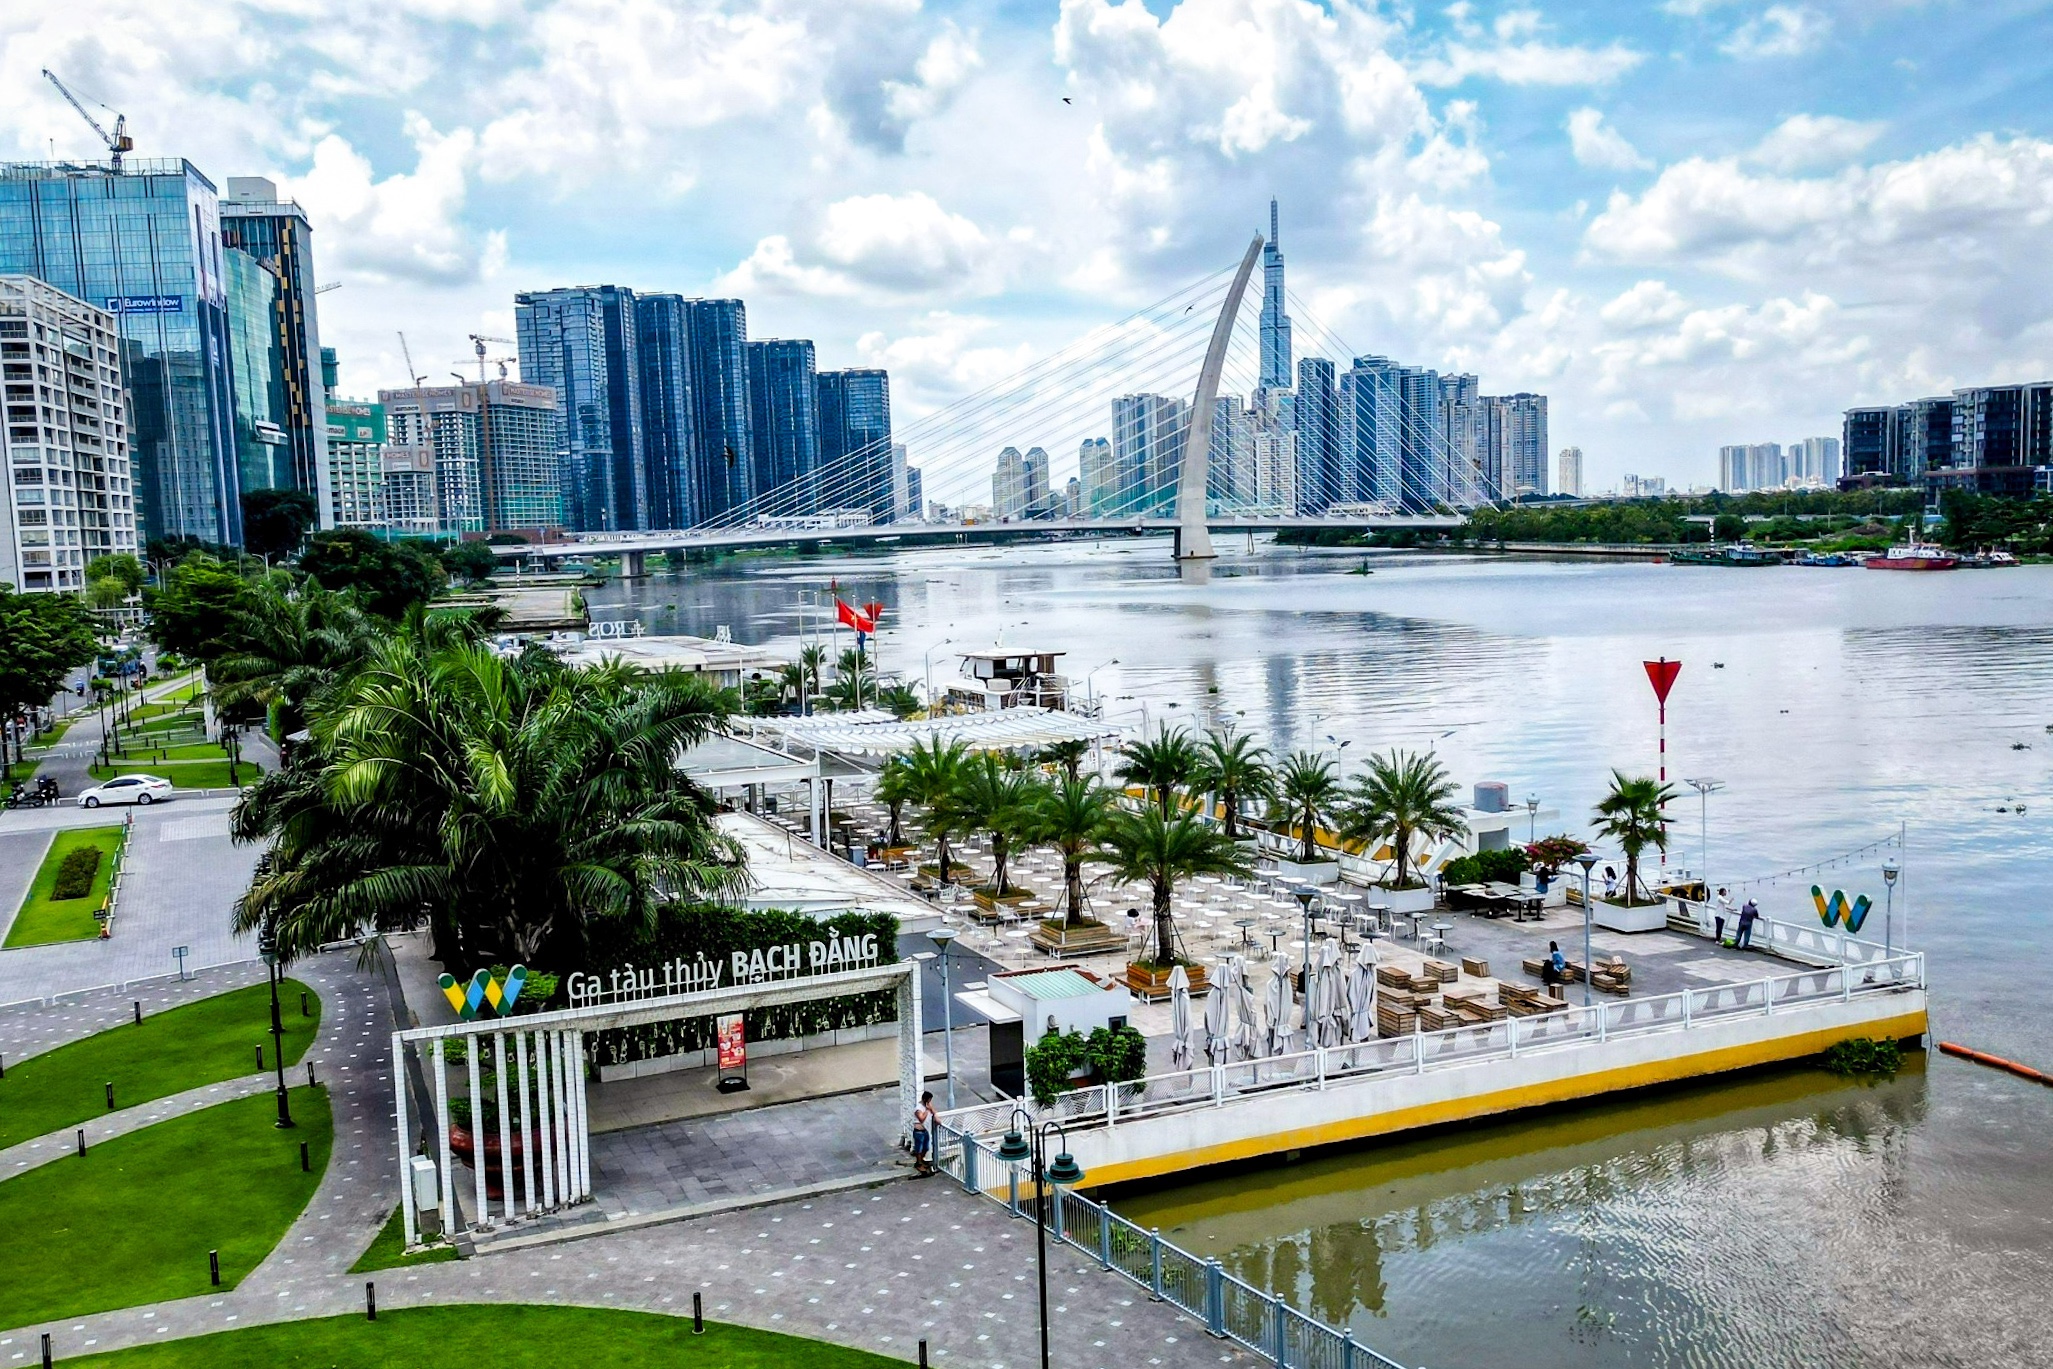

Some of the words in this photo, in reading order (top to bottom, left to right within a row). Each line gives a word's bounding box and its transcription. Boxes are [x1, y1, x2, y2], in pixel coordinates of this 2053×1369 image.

[567, 971, 602, 999] Ga
[610, 963, 654, 993] tàu
[662, 951, 724, 988] thủy
[731, 943, 801, 982] BẠCH
[809, 926, 878, 967] ĐẰNG
